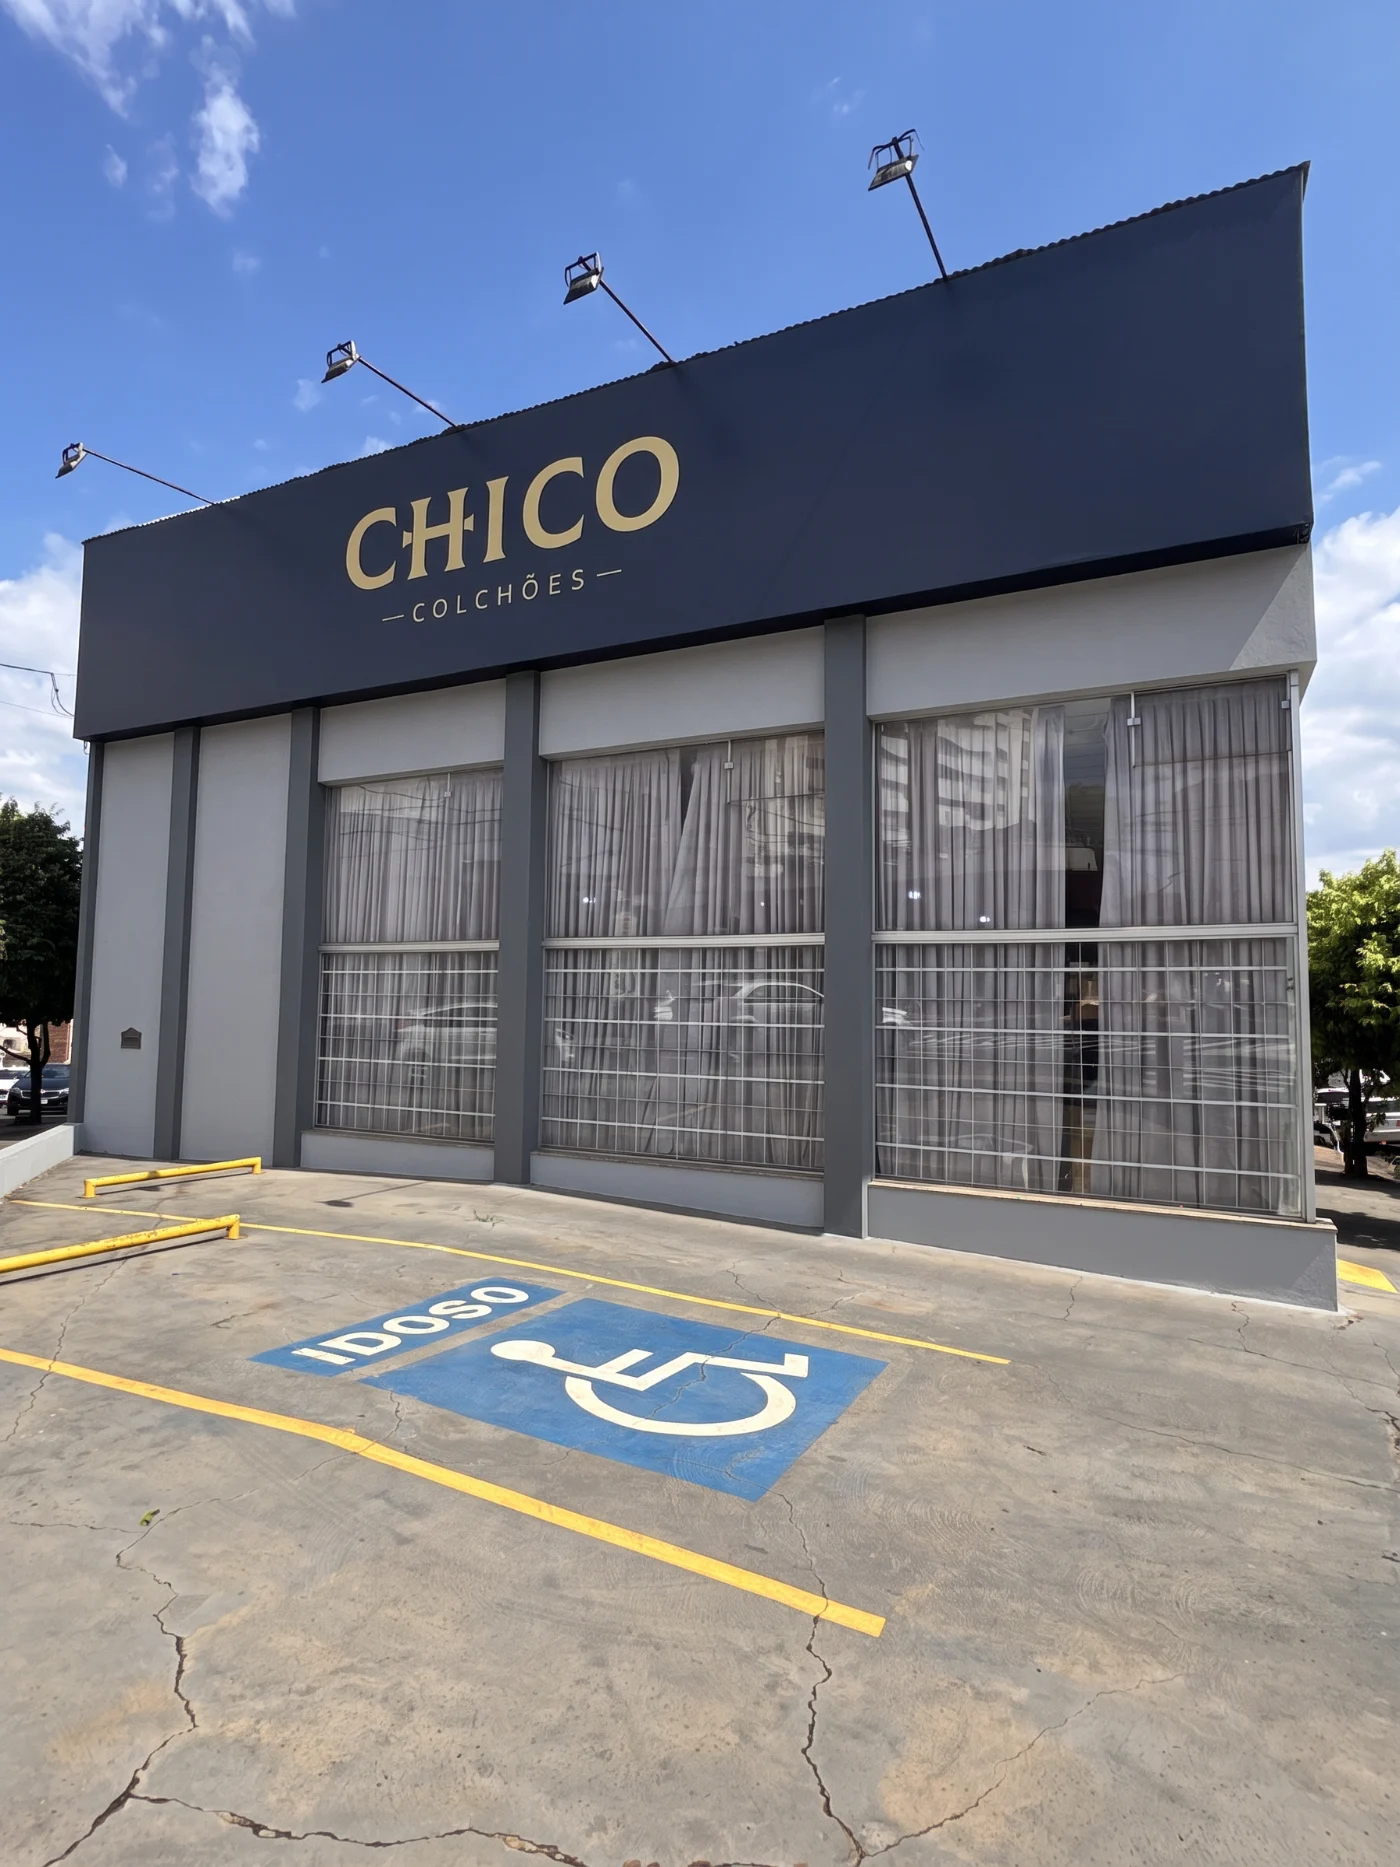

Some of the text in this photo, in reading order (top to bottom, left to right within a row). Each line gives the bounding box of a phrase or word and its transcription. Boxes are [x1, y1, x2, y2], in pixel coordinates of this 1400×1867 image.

[345, 436, 680, 590] CHICO
[412, 568, 585, 623] COLCHÕES
[291, 1286, 530, 1366] IDOSO
